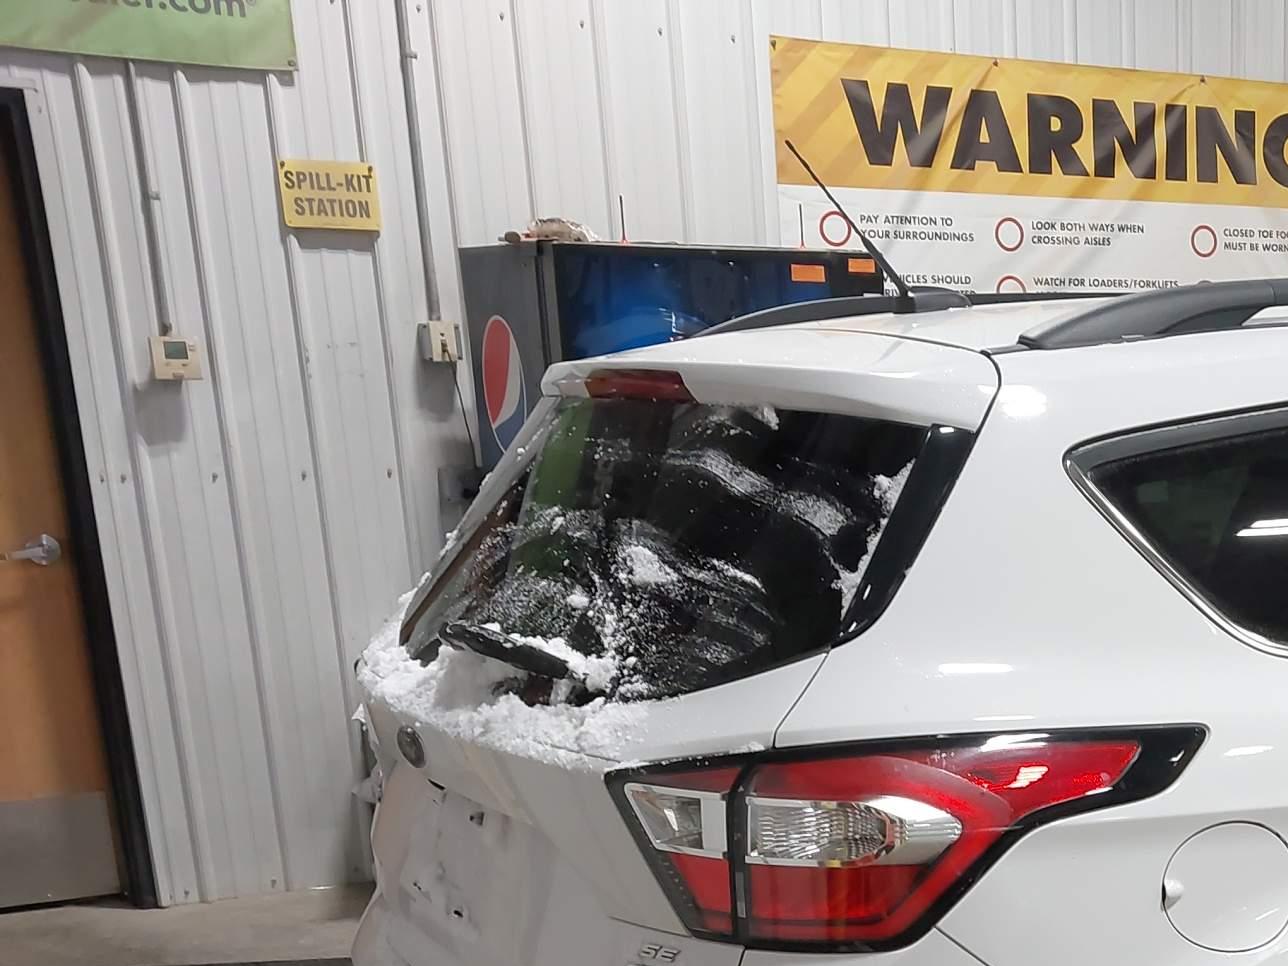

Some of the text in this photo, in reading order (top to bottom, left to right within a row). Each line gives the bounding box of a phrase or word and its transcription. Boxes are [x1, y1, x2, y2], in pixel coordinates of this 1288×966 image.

[284, 170, 373, 193] SPILL-KIT
[294, 197, 371, 218] STATION
[859, 214, 953, 227] PAY ATTENTION TO
[1031, 221, 1145, 234] LOOK BOTH WAYS WHEN
[1223, 228, 1255, 239] CLOSED
[1257, 229, 1274, 239] TOE
[861, 229, 975, 242] YOUR SURROUNDINGS
[1031, 235, 1112, 247] CROSSING AISLES
[1223, 241, 1248, 252] MUST
[1249, 242, 1260, 252] BE
[930, 275, 972, 286] SHOULD
[1033, 277, 1179, 289] WATCH FOR LOADERS/FORKLIFTS
[640, 944, 681, 963] SE
